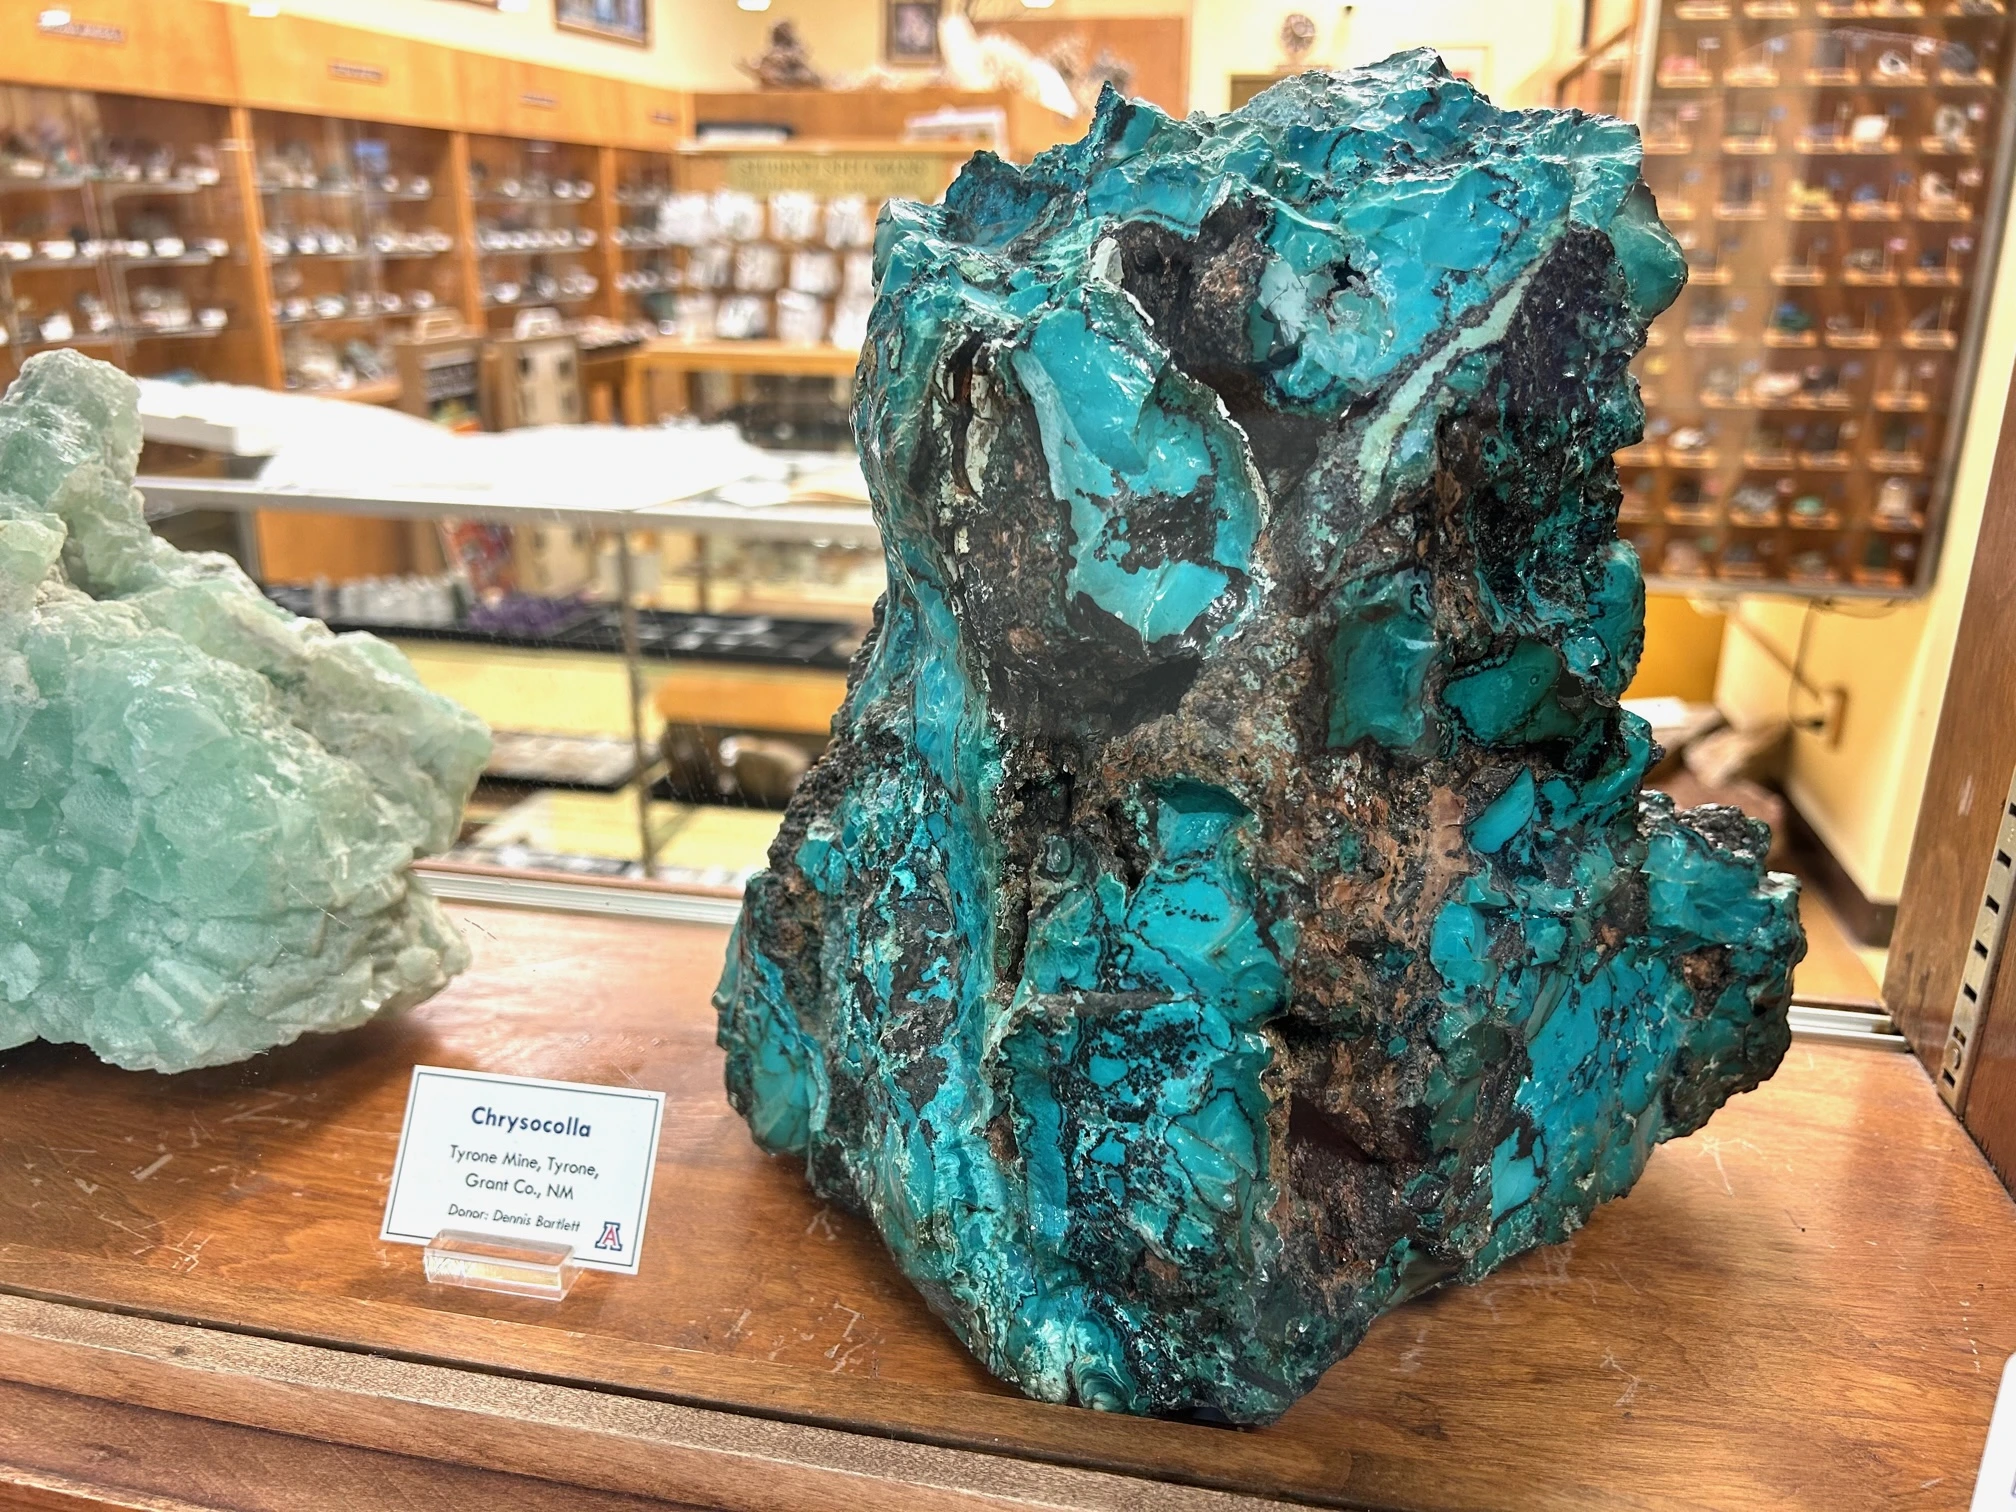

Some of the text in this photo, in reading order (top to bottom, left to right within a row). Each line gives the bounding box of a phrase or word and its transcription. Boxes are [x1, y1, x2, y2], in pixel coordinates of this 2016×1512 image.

[472, 1106, 591, 1137] Chrysocolla
[450, 1145, 600, 1179] Tyrone Mine, Tyrone,
[466, 1173, 573, 1199] Grant Co., NM
[448, 1204, 580, 1231] Donor: Dennis Bartlett
